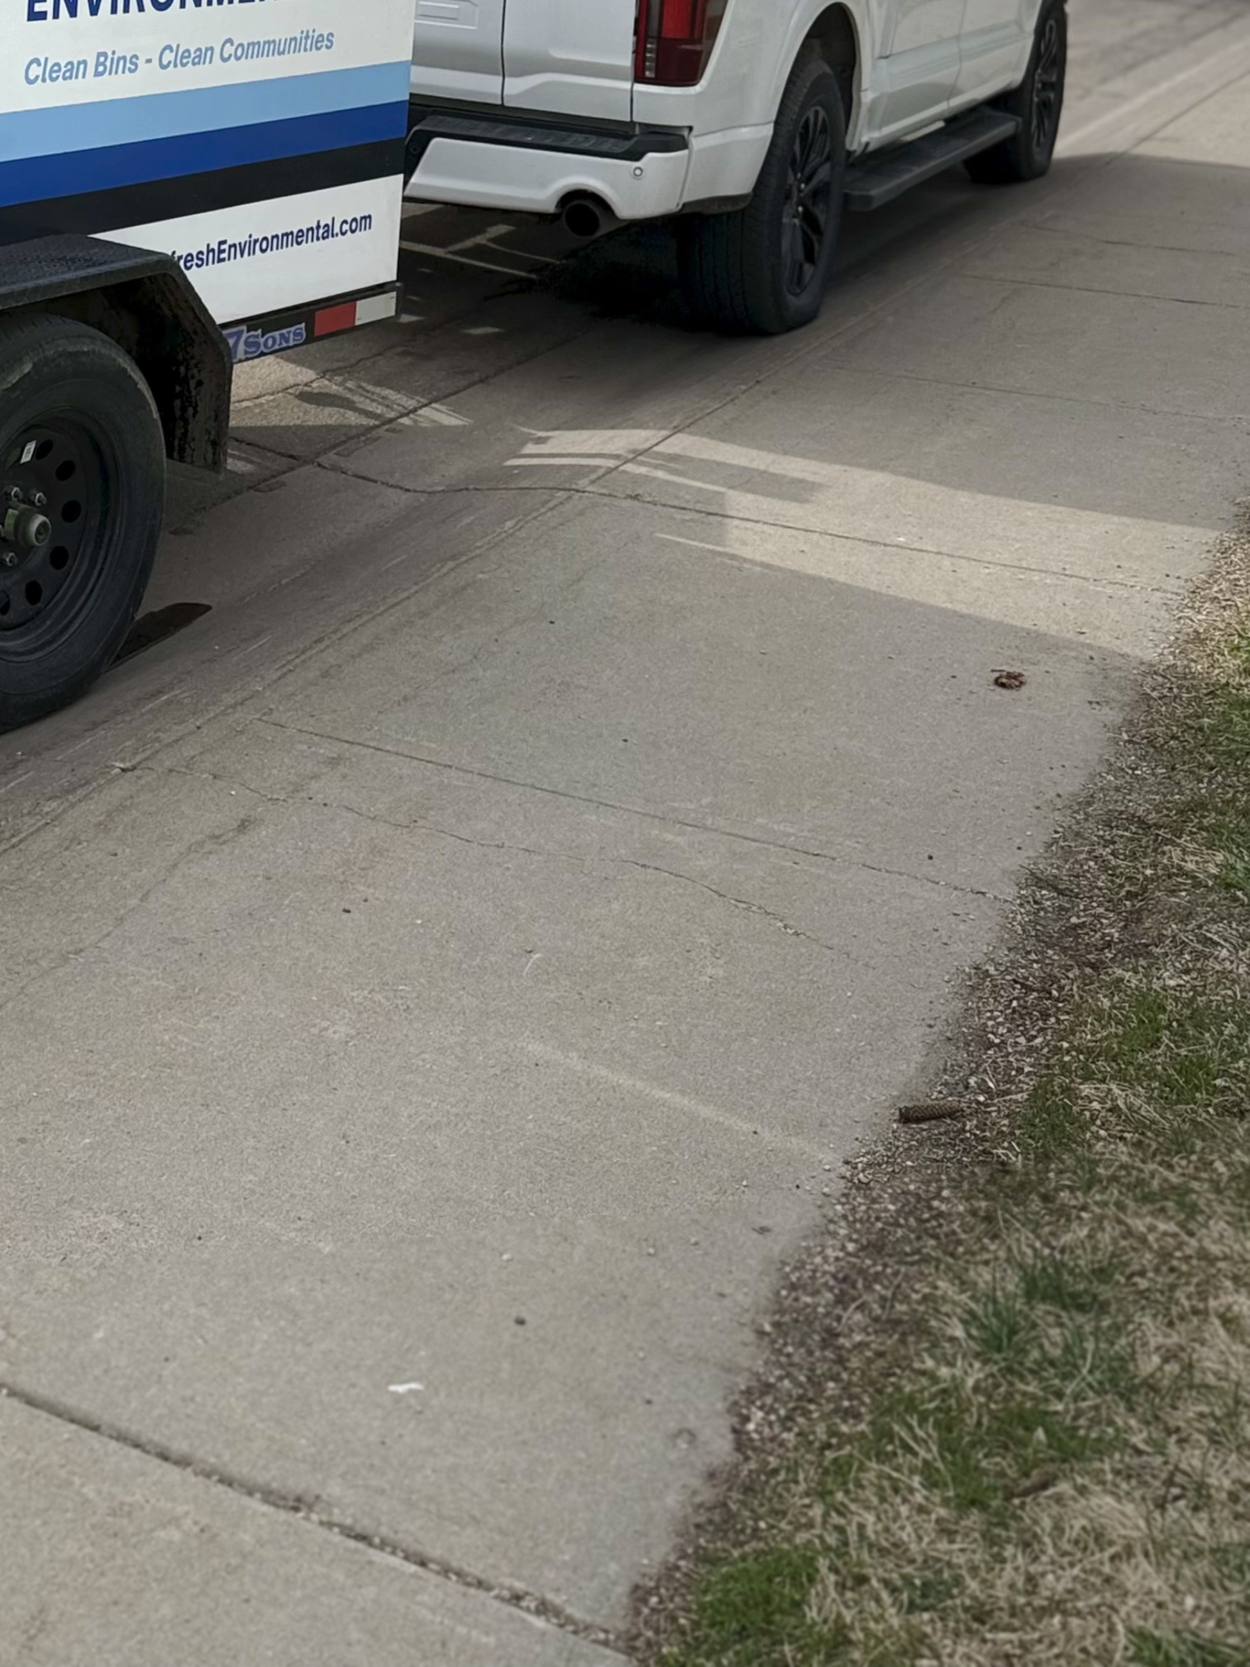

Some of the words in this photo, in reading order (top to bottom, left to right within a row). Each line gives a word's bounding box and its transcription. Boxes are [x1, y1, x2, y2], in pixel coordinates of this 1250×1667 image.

[24, 56, 88, 85] Clean
[93, 50, 139, 78] Bins
[158, 43, 215, 70] Clean
[219, 28, 335, 62] Communities
